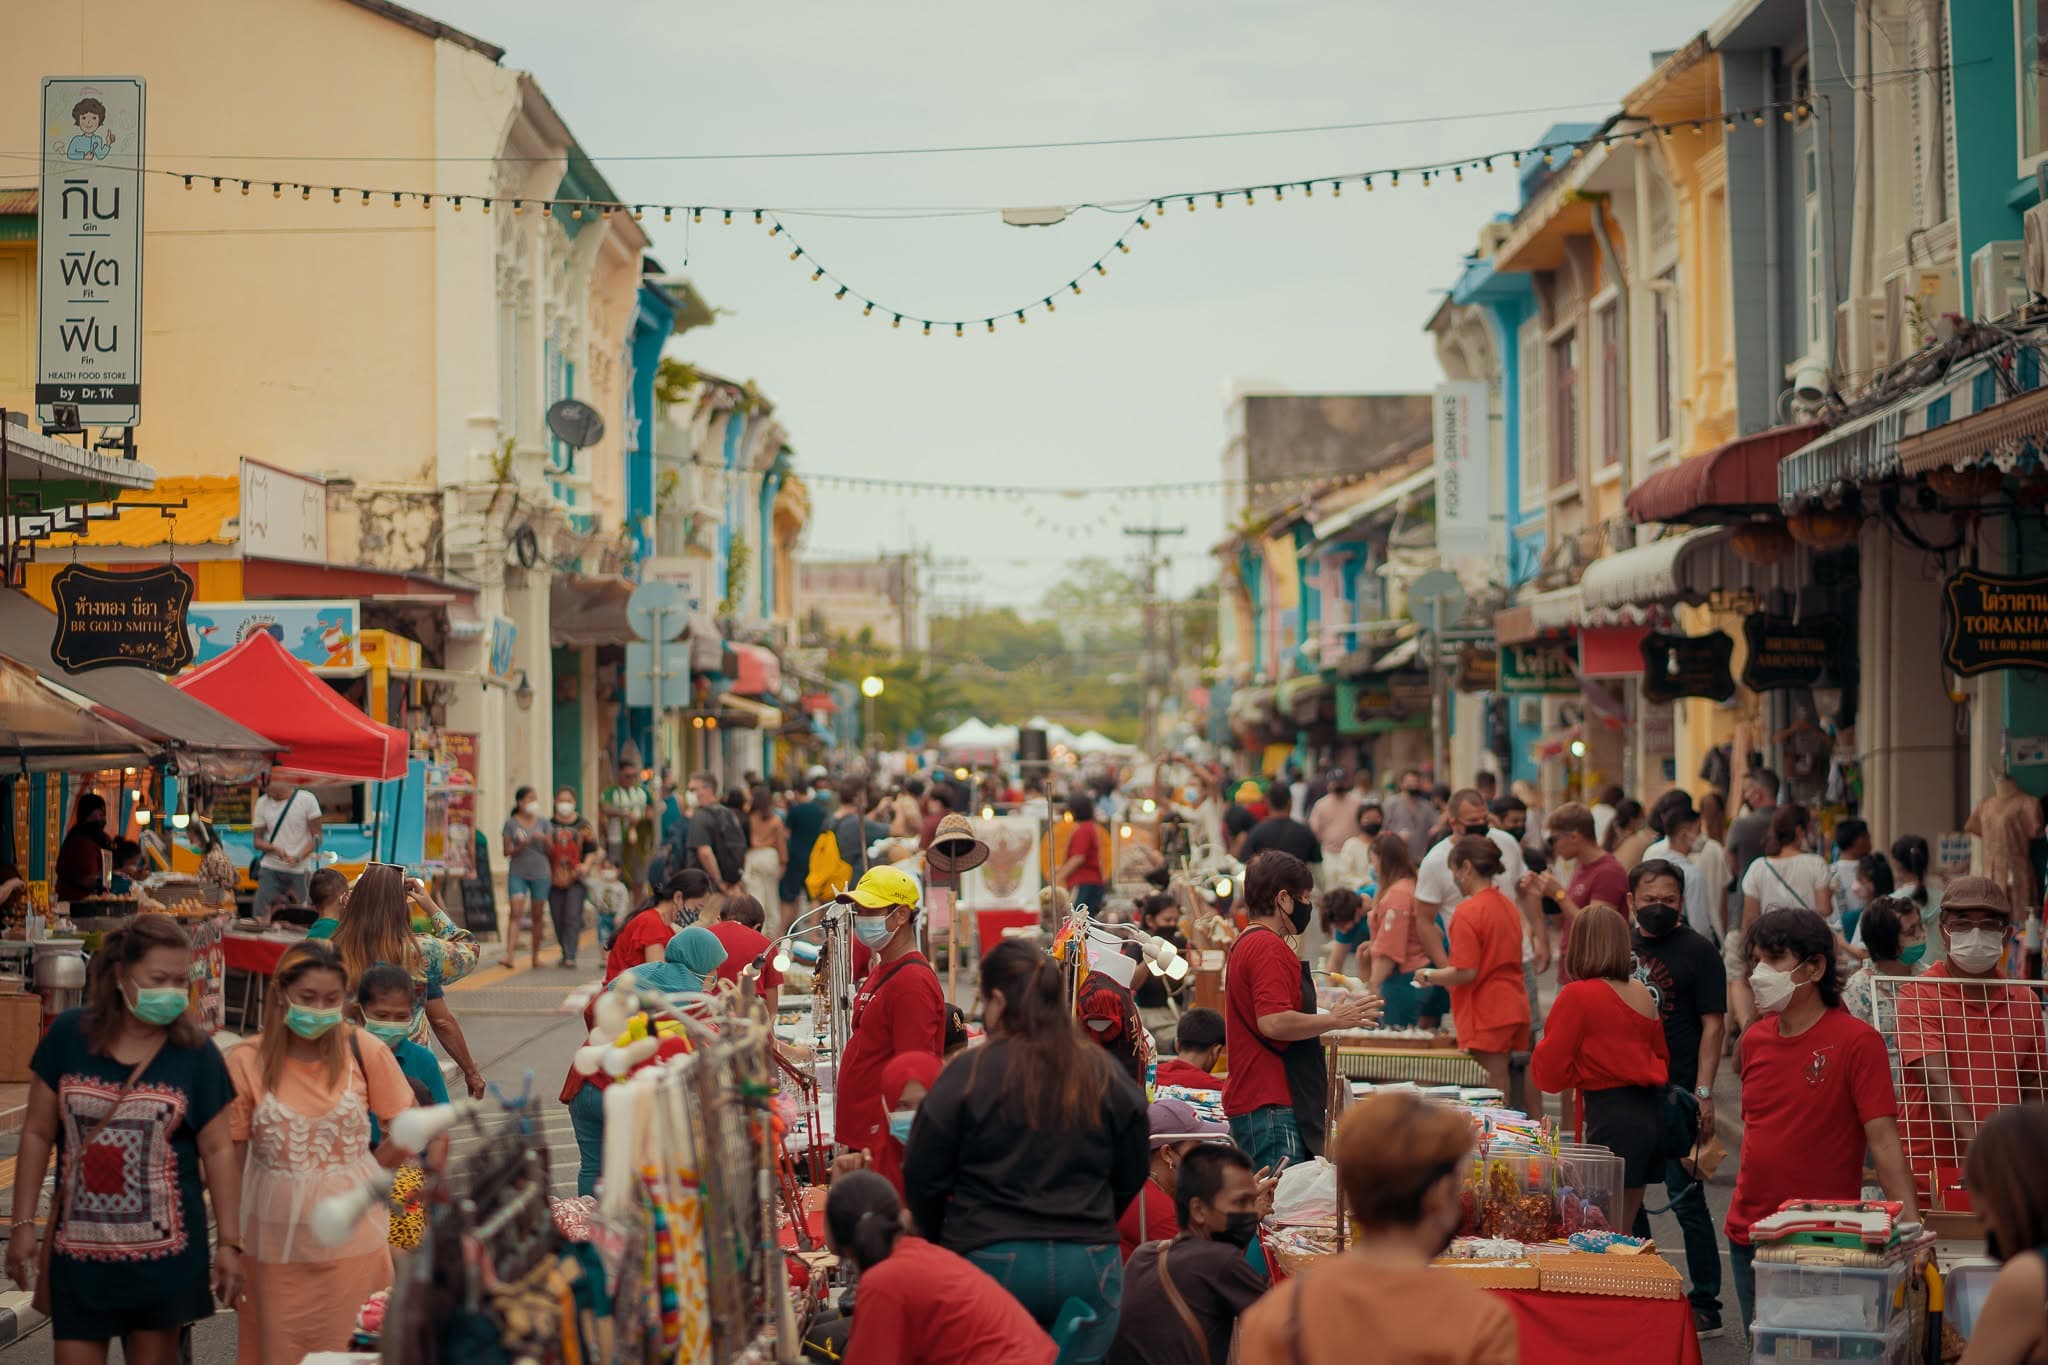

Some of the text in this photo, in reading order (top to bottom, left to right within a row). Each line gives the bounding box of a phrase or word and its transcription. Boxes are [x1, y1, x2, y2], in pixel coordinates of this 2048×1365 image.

[62, 179, 119, 219] กิน
[82, 223, 97, 231] Gin
[82, 289, 94, 298] Fit
[81, 356, 94, 365] Fin
[60, 387, 75, 400] by
[71, 620, 162, 632] BR GOLD SMITH
